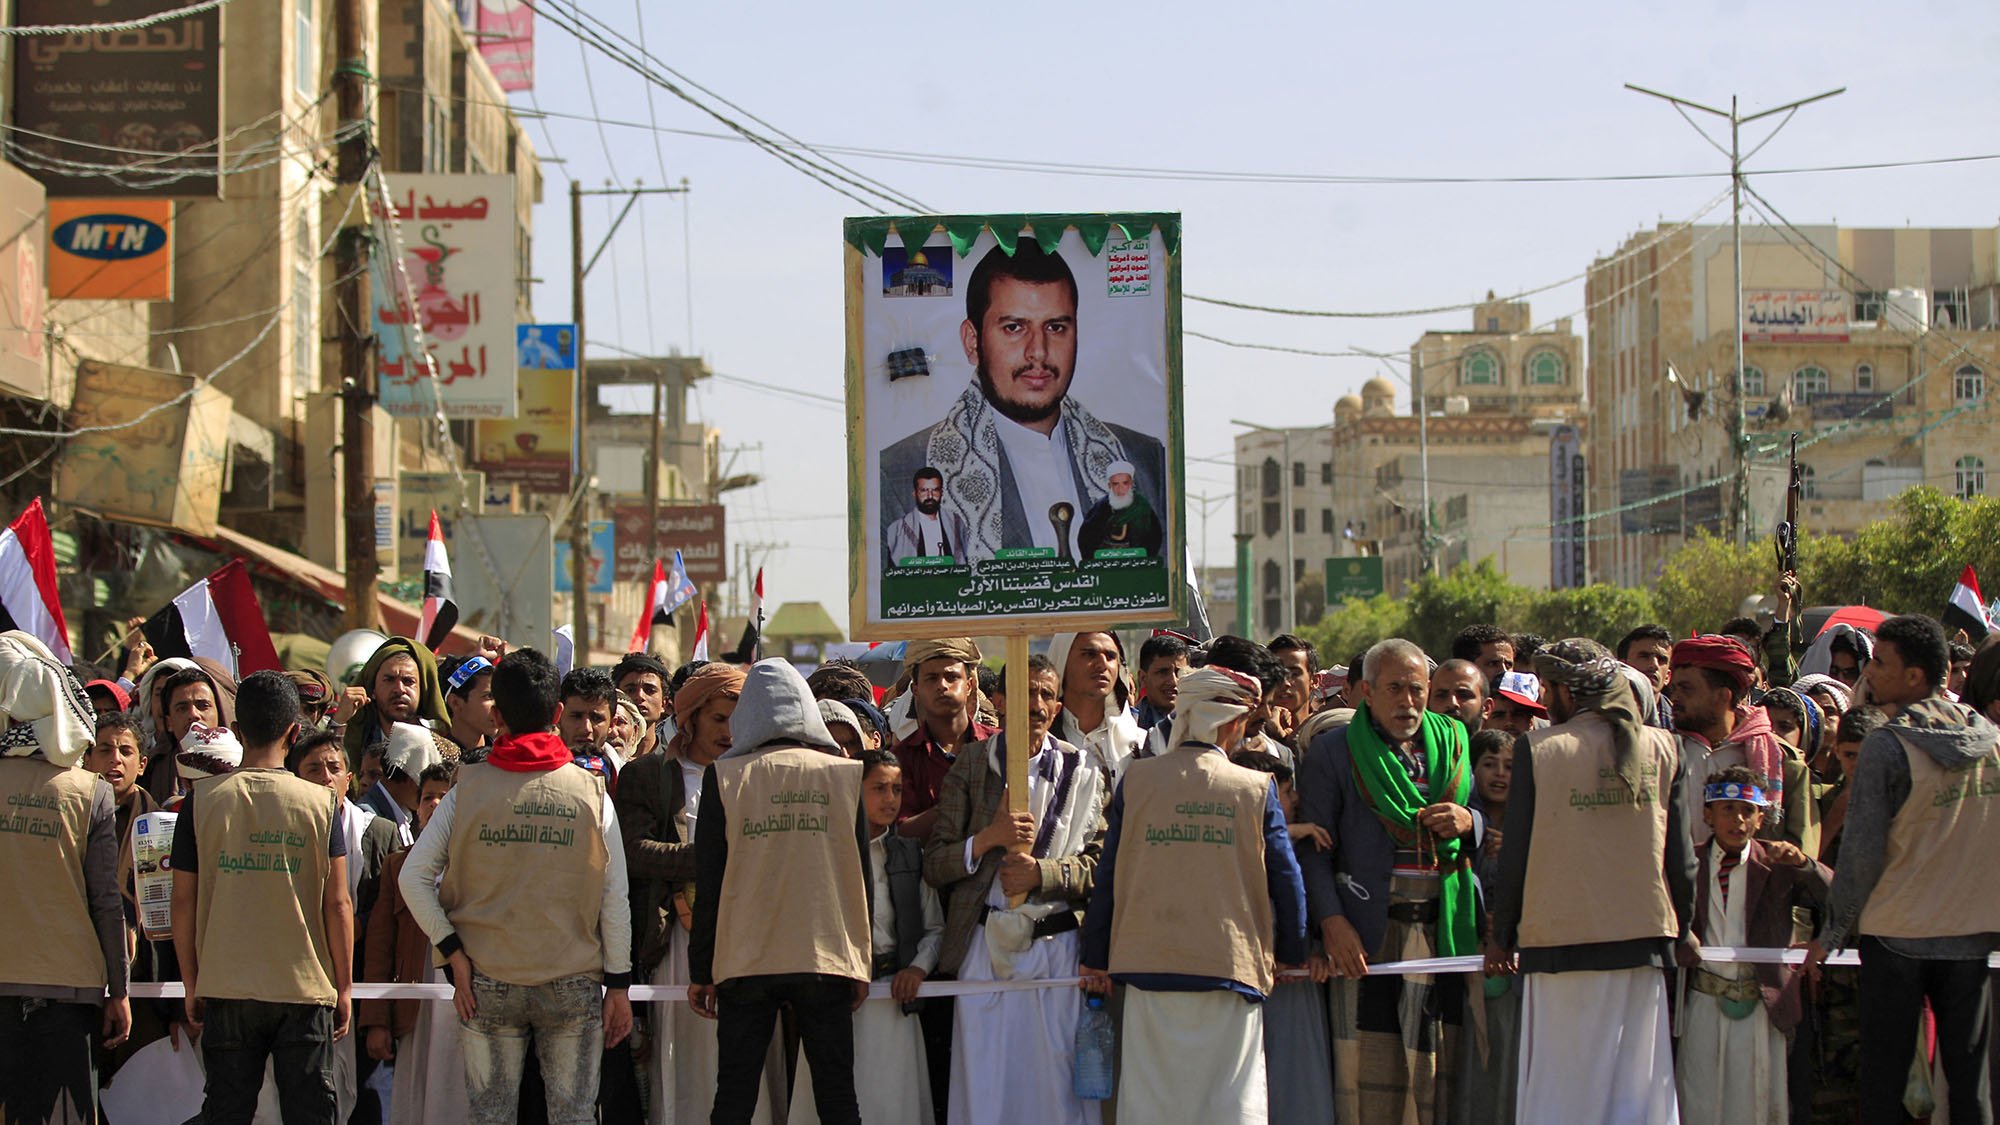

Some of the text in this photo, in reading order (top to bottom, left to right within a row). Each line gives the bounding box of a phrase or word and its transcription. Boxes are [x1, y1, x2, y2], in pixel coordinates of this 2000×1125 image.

[71, 223, 148, 251] MTN
[1133, 241, 1148, 250] الله
[1131, 254, 1148, 262] الموت
[1131, 264, 1149, 272] الموت
[378, 293, 480, 334] الجرف
[1748, 305, 1813, 333] الجلدية
[1006, 549, 1048, 557] السيد القائد
[885, 568, 905, 577] الحوثي
[979, 562, 1007, 573] الحوثي
[958, 575, 1099, 597] القدس قضيتنا الأولى
[887, 592, 1165, 617] ماضون بعون الله لتحرير القدس من الصهاينة وأعوانهم
[7, 792, 47, 810] الفعاليات
[770, 790, 829, 808] لجنة الفعاليات
[1570, 786, 1625, 812] التنظيمية
[513, 802, 577, 822] لجنة الفعاليات
[1175, 800, 1236, 820] لجنة الفعاليات
[28, 817, 63, 842] اللجنة
[478, 823, 574, 849] اللجنة التنظيمية
[742, 812, 829, 840] اللجنة التنظيمية
[1144, 823, 1235, 848] اللجنة التنظيمية
[249, 830, 307, 851] لجنة الفعاليات
[218, 850, 302, 875] اللنة التنظيمية
